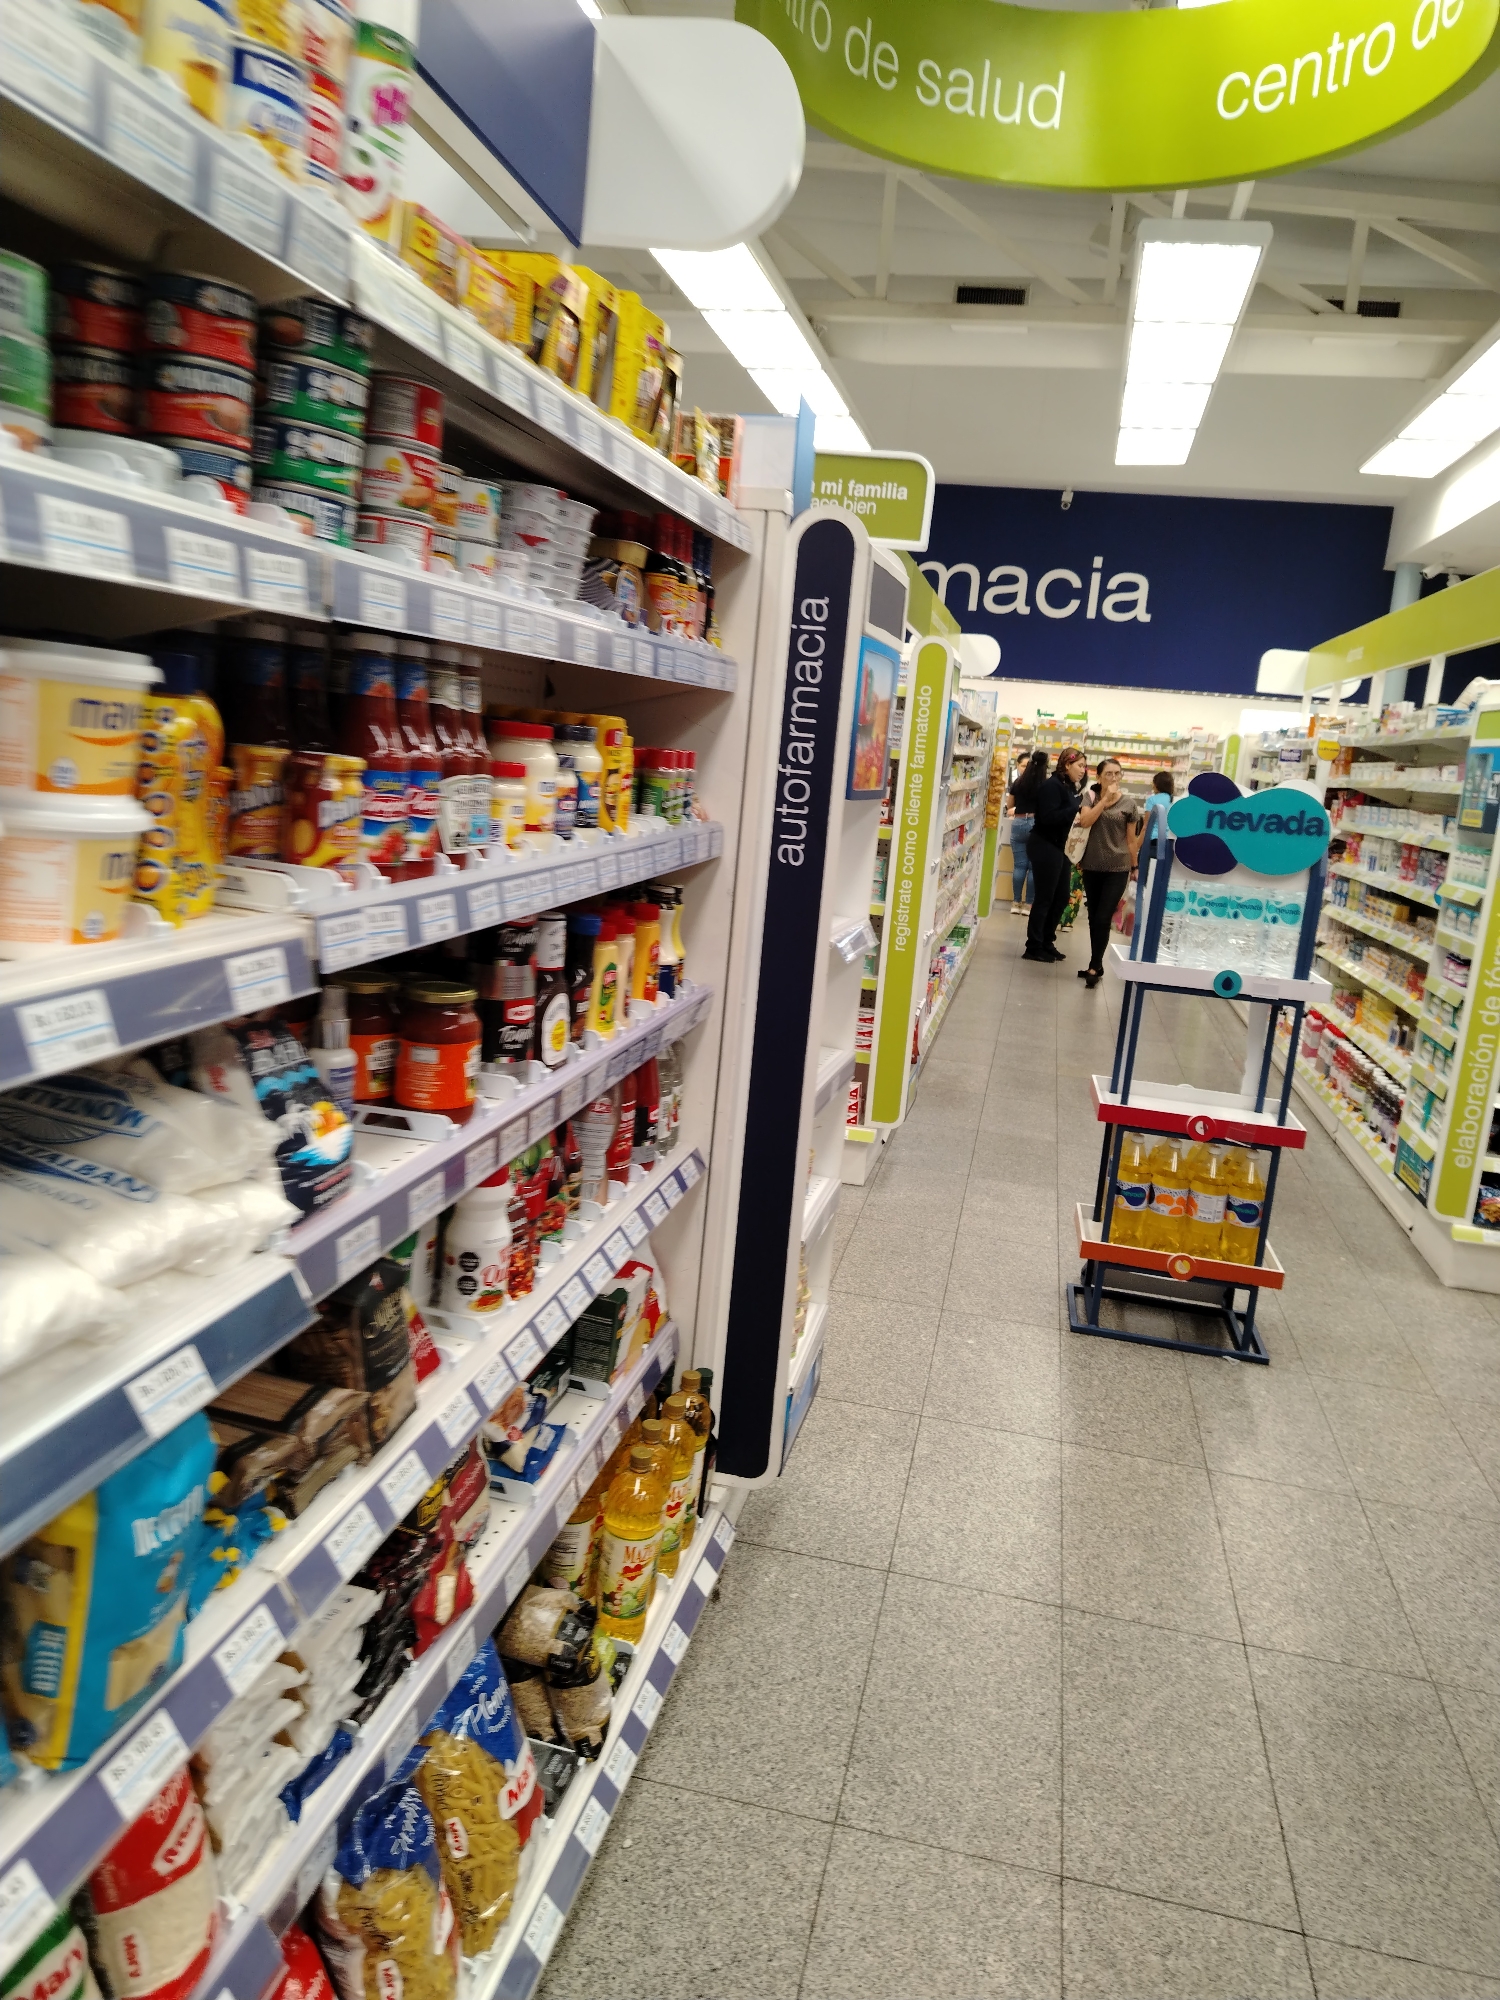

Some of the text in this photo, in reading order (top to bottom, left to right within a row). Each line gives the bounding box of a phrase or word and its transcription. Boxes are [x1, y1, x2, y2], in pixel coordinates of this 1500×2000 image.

[844, 16, 899, 91] de
[915, 58, 1066, 130] salud
[1216, 21, 1396, 120] centro
[820, 479, 843, 496] mi
[848, 479, 908, 501] familia
[777, 596, 830, 867] autofarmacia
[893, 684, 934, 952] regístrate como cliente farmatodo
[1206, 809, 1325, 837] nevada
[1454, 1043, 1494, 1170] elaboración
